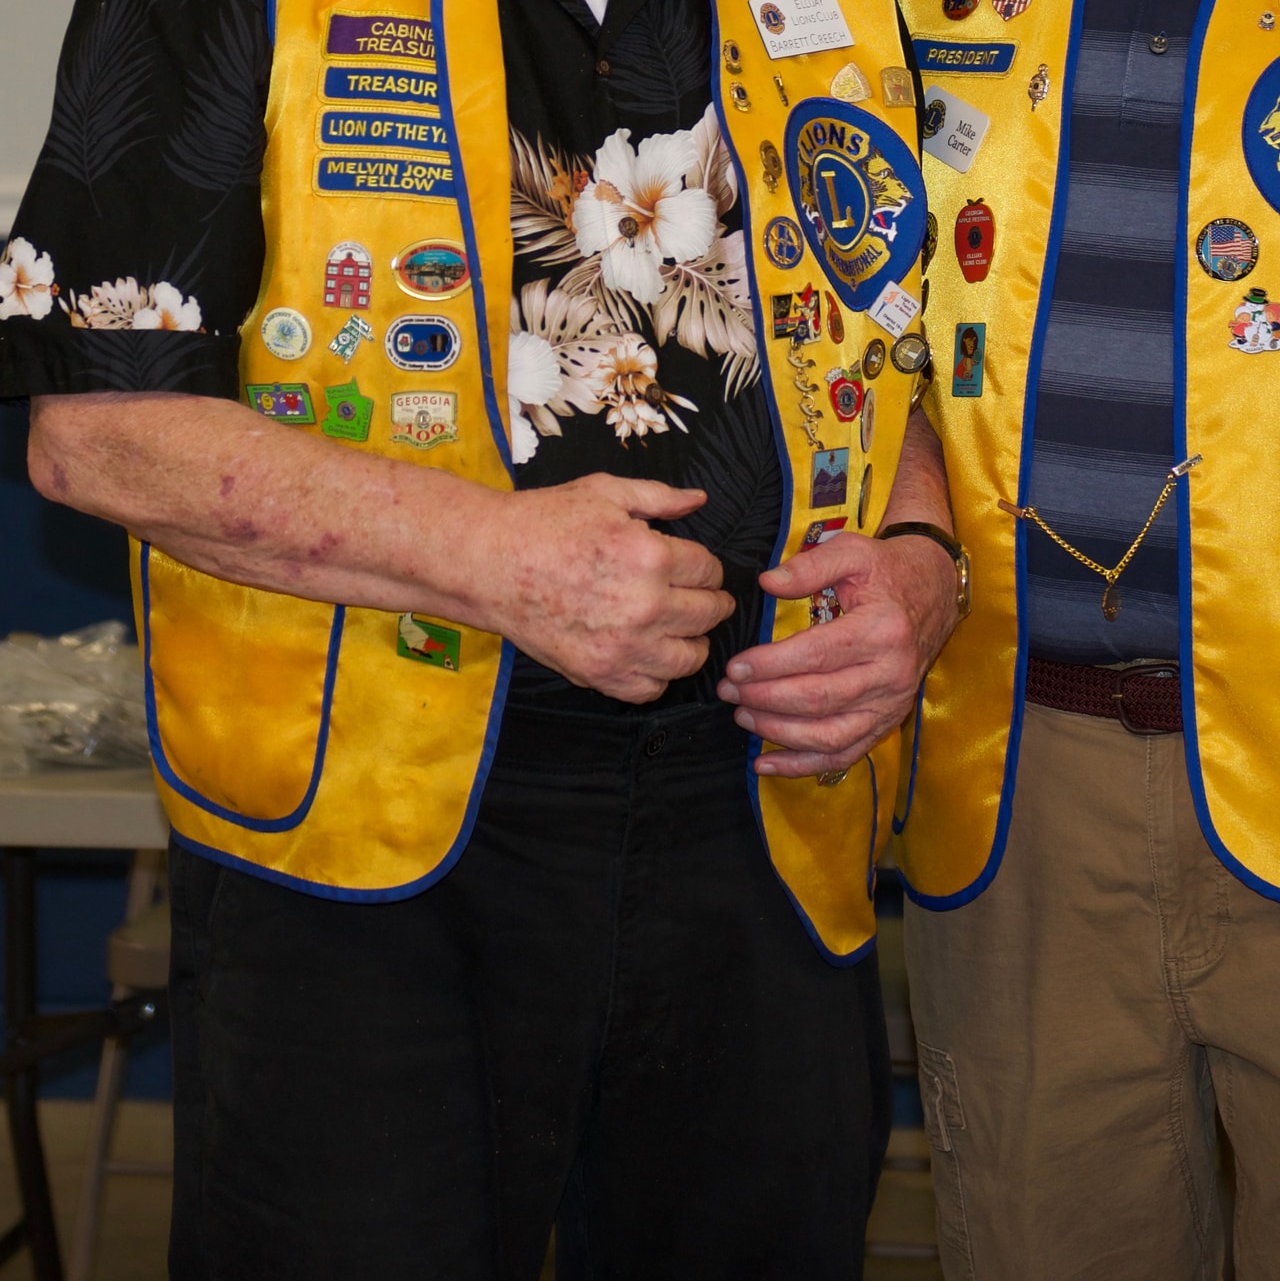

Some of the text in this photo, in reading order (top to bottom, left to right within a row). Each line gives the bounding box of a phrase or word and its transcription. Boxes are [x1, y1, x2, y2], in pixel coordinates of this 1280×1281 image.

[791, 10, 839, 26] LIONS CLUB
[770, 30, 847, 53] BARRETT CREECH
[926, 47, 1000, 66] PRESIDENT
[347, 75, 438, 98] TREASUR
[329, 119, 367, 137] LION
[371, 120, 394, 138] OF
[395, 123, 428, 142] THE
[800, 122, 864, 158] LIONS
[956, 120, 976, 140] Mike
[947, 134, 972, 156] Carter
[327, 160, 454, 181] MELVIN JONE
[355, 175, 434, 192] FELLOW
[820, 171, 856, 229] L
[396, 396, 450, 406] GEORGIA
